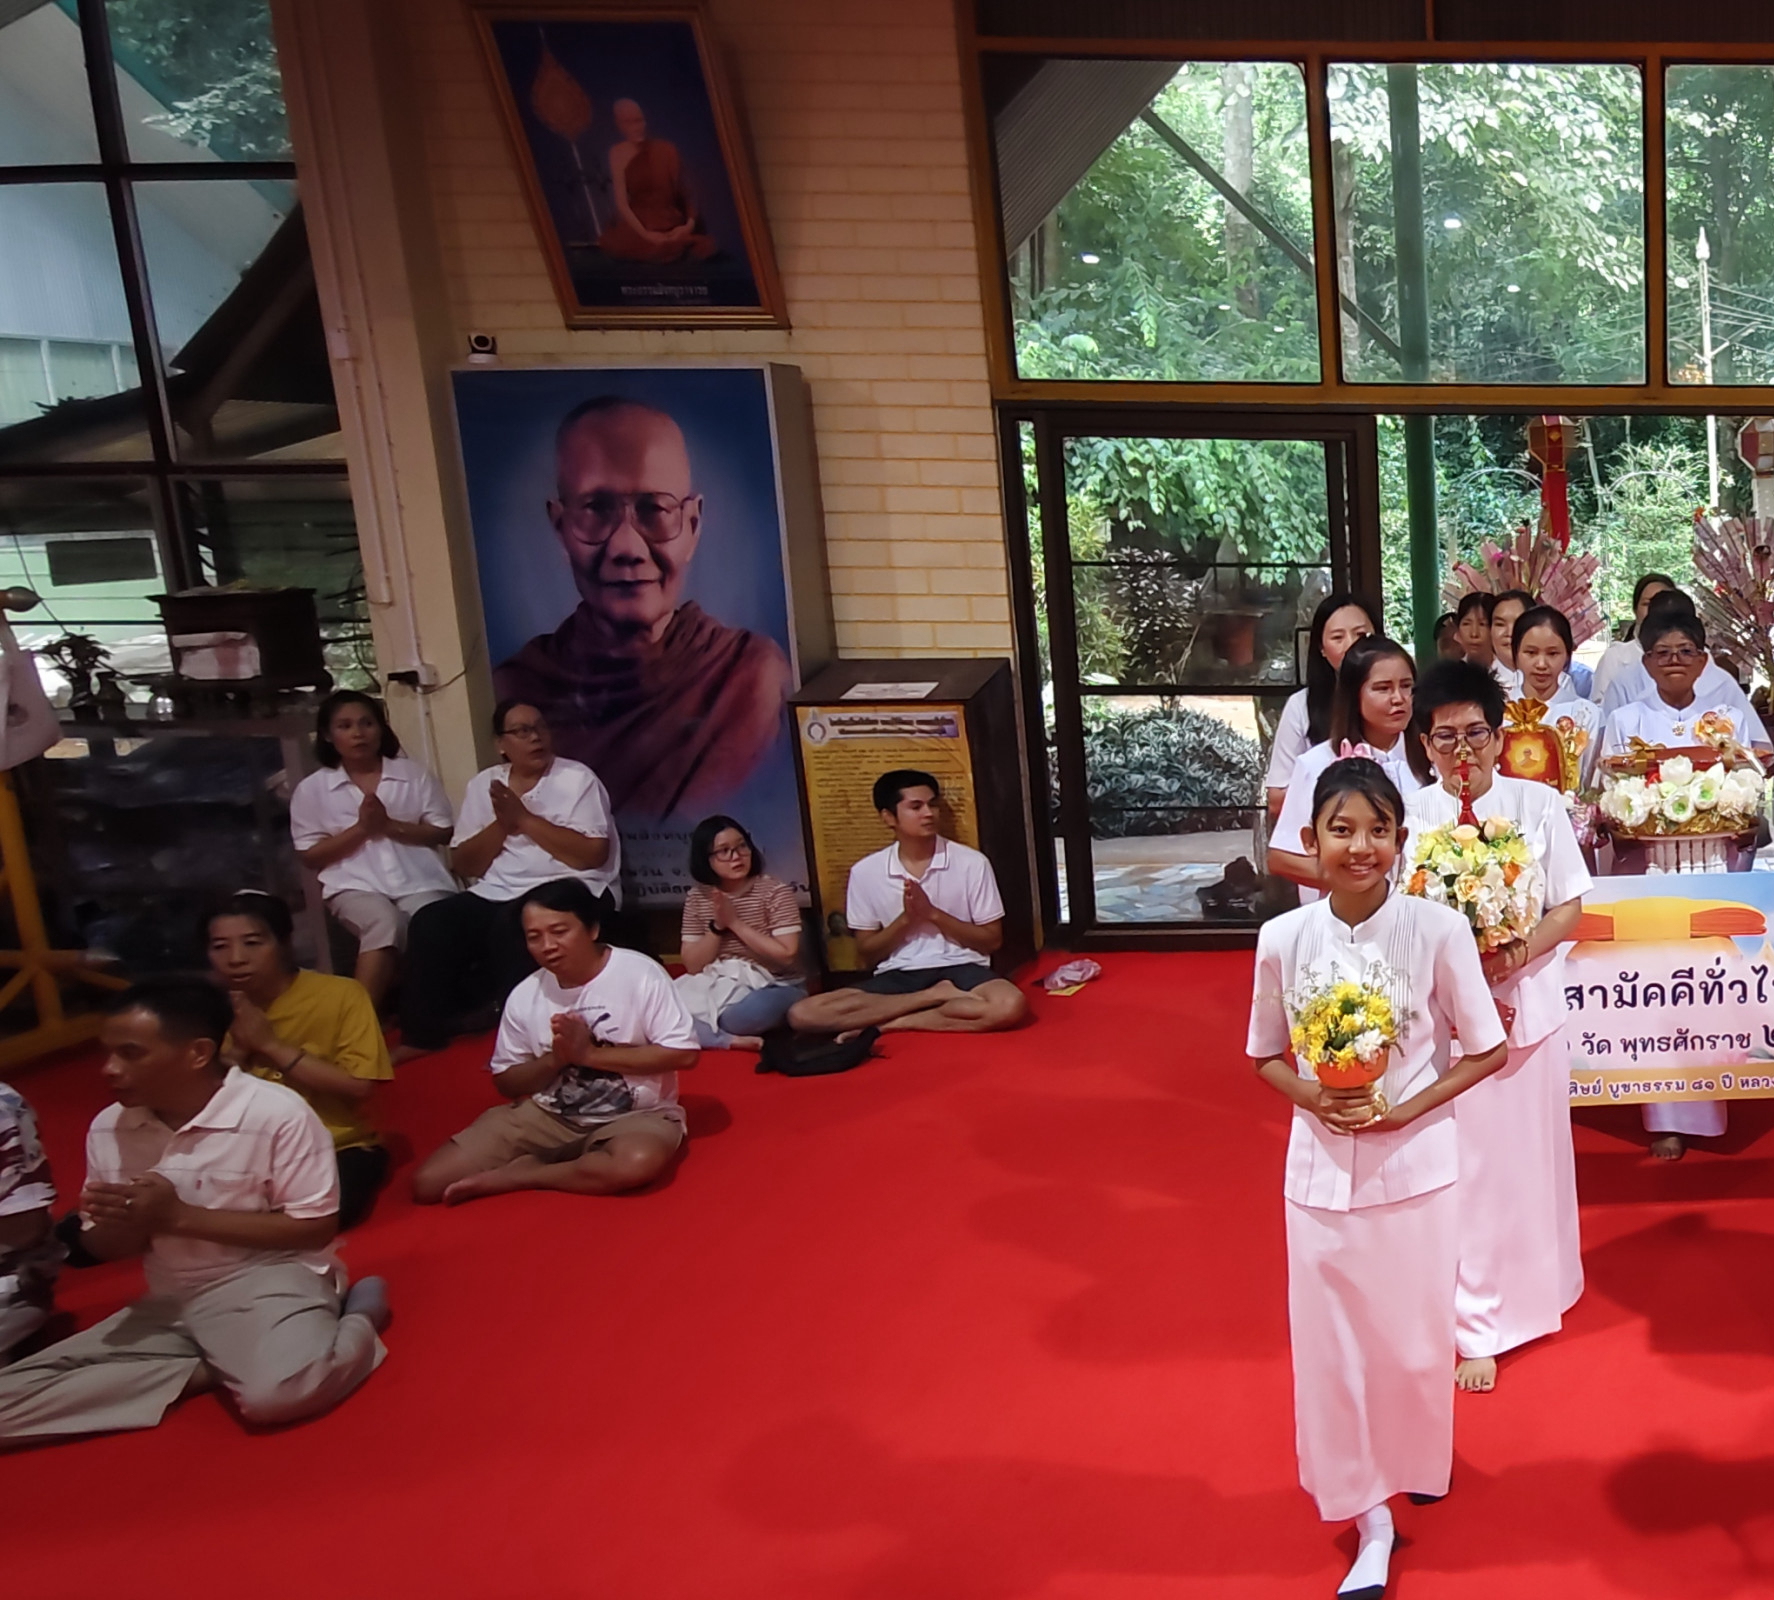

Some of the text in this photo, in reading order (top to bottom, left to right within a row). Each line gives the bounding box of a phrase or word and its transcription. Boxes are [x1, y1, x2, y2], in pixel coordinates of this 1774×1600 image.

[1580, 1031, 1612, 1056] วัด
[1619, 1028, 1752, 1062] พุทธศักราช
[1608, 1079, 1686, 1099] บูชาธรรม
[1691, 1079, 1716, 1091] ๘๑
[1721, 1073, 1733, 1090] ปี
